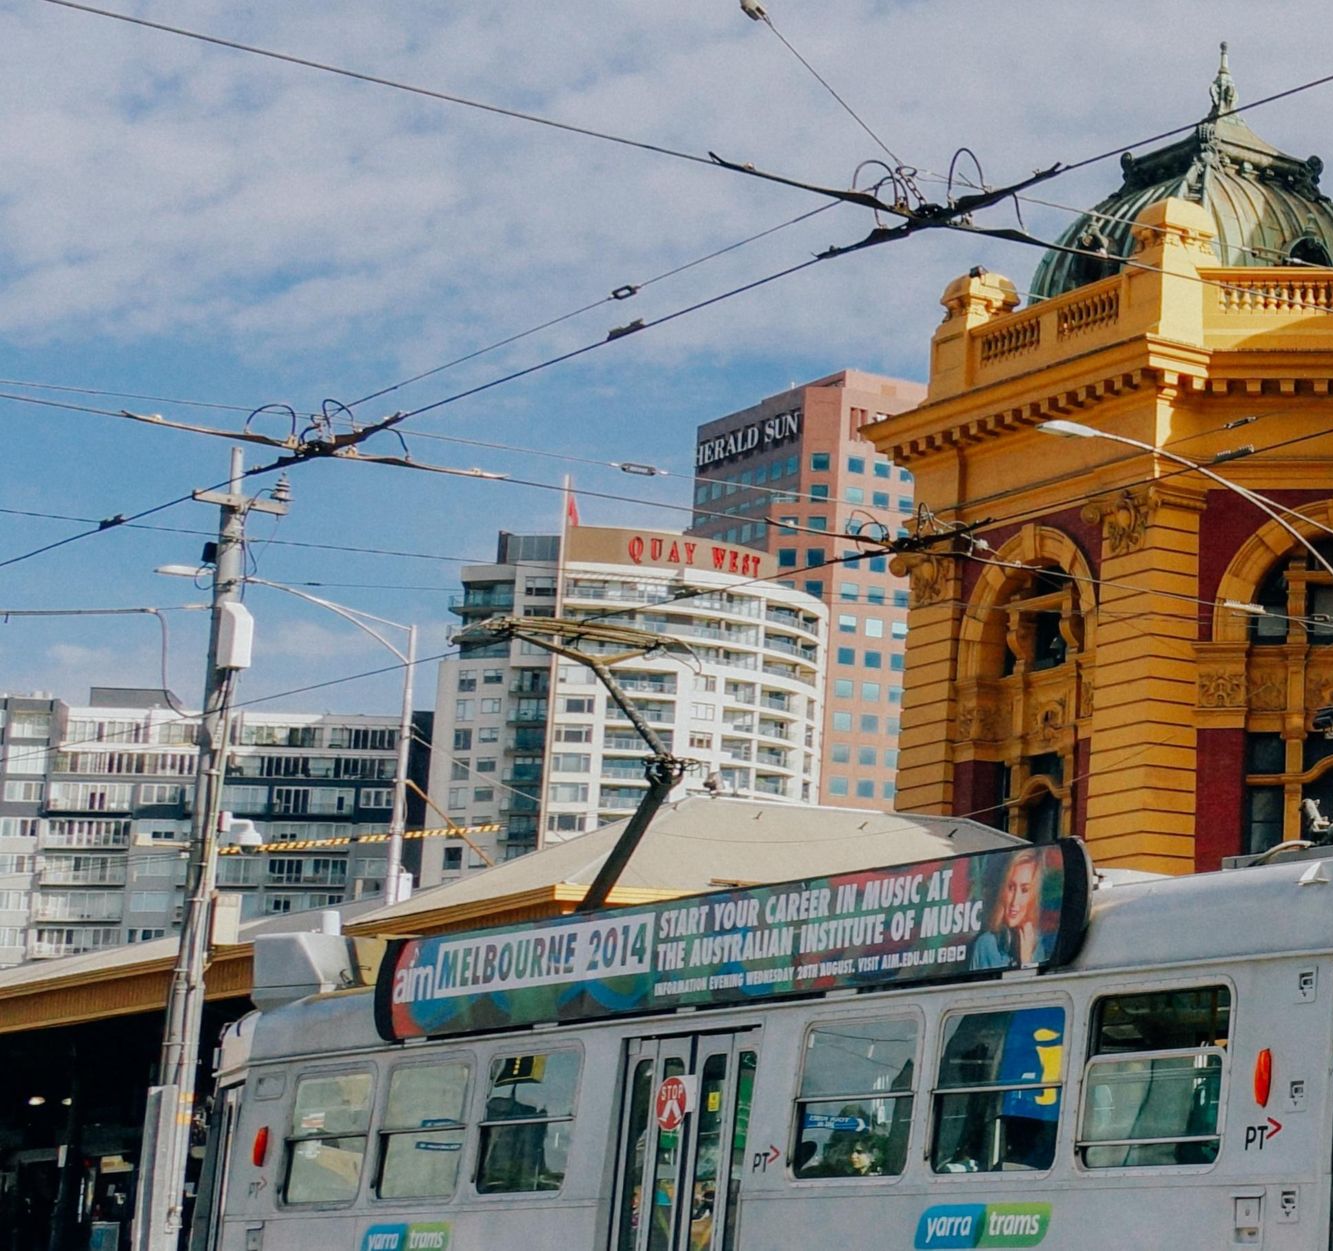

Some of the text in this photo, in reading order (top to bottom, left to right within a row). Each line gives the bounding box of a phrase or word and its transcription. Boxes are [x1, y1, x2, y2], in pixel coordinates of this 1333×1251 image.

[696, 412, 800, 466] HERALD SUN
[628, 536, 761, 578] QUAY WEST
[659, 869, 953, 939] START YOUR CAREER IN MUSIC AT
[657, 900, 983, 972] THE AUSTRALIAN INSTITUTE OF MUSIC
[394, 923, 648, 1004] aim MELBOURNE 2014
[654, 977, 708, 997] INFORMATION
[709, 972, 744, 990] EVENING
[745, 967, 794, 986] WEDNESDAY
[858, 955, 880, 972] VISIT
[881, 947, 936, 969] AIM.EDU.AU
[661, 1083, 684, 1101] STOP
[367, 1229, 445, 1251] yarra trams
[925, 1211, 1041, 1244] yarra trams
